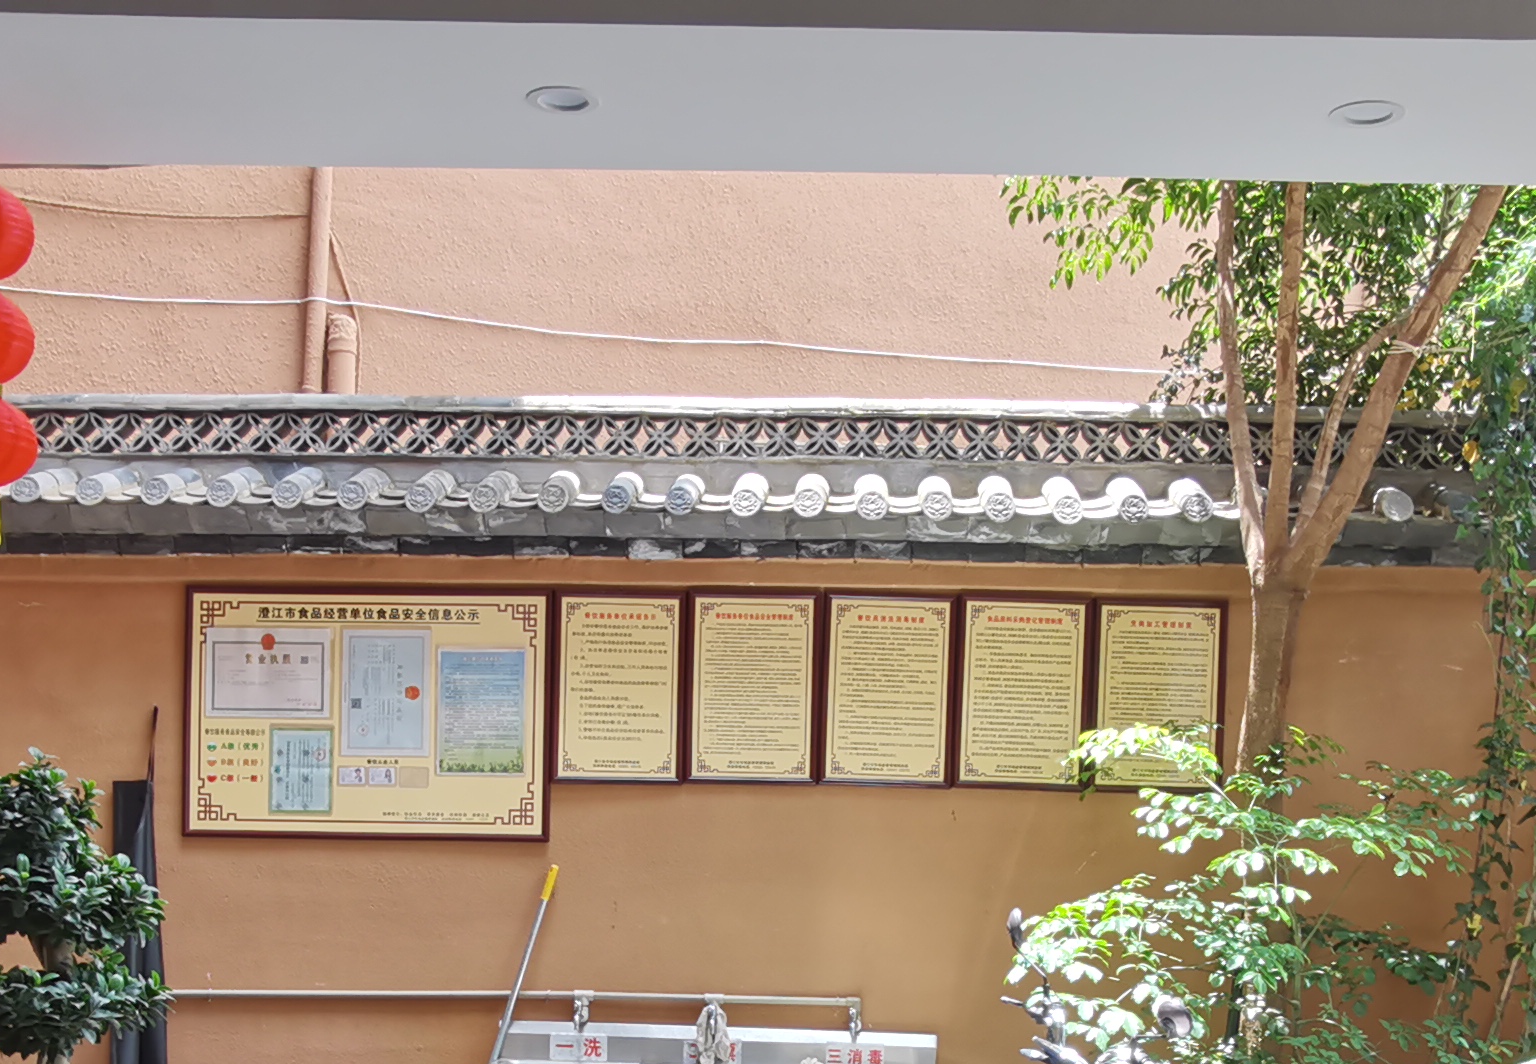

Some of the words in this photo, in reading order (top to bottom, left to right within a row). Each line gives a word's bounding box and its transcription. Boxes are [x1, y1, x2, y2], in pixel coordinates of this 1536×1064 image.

[257, 606, 480, 621] 澄江市食品经营单位食品安全信息公示
[555, 1037, 602, 1058] 一洗
